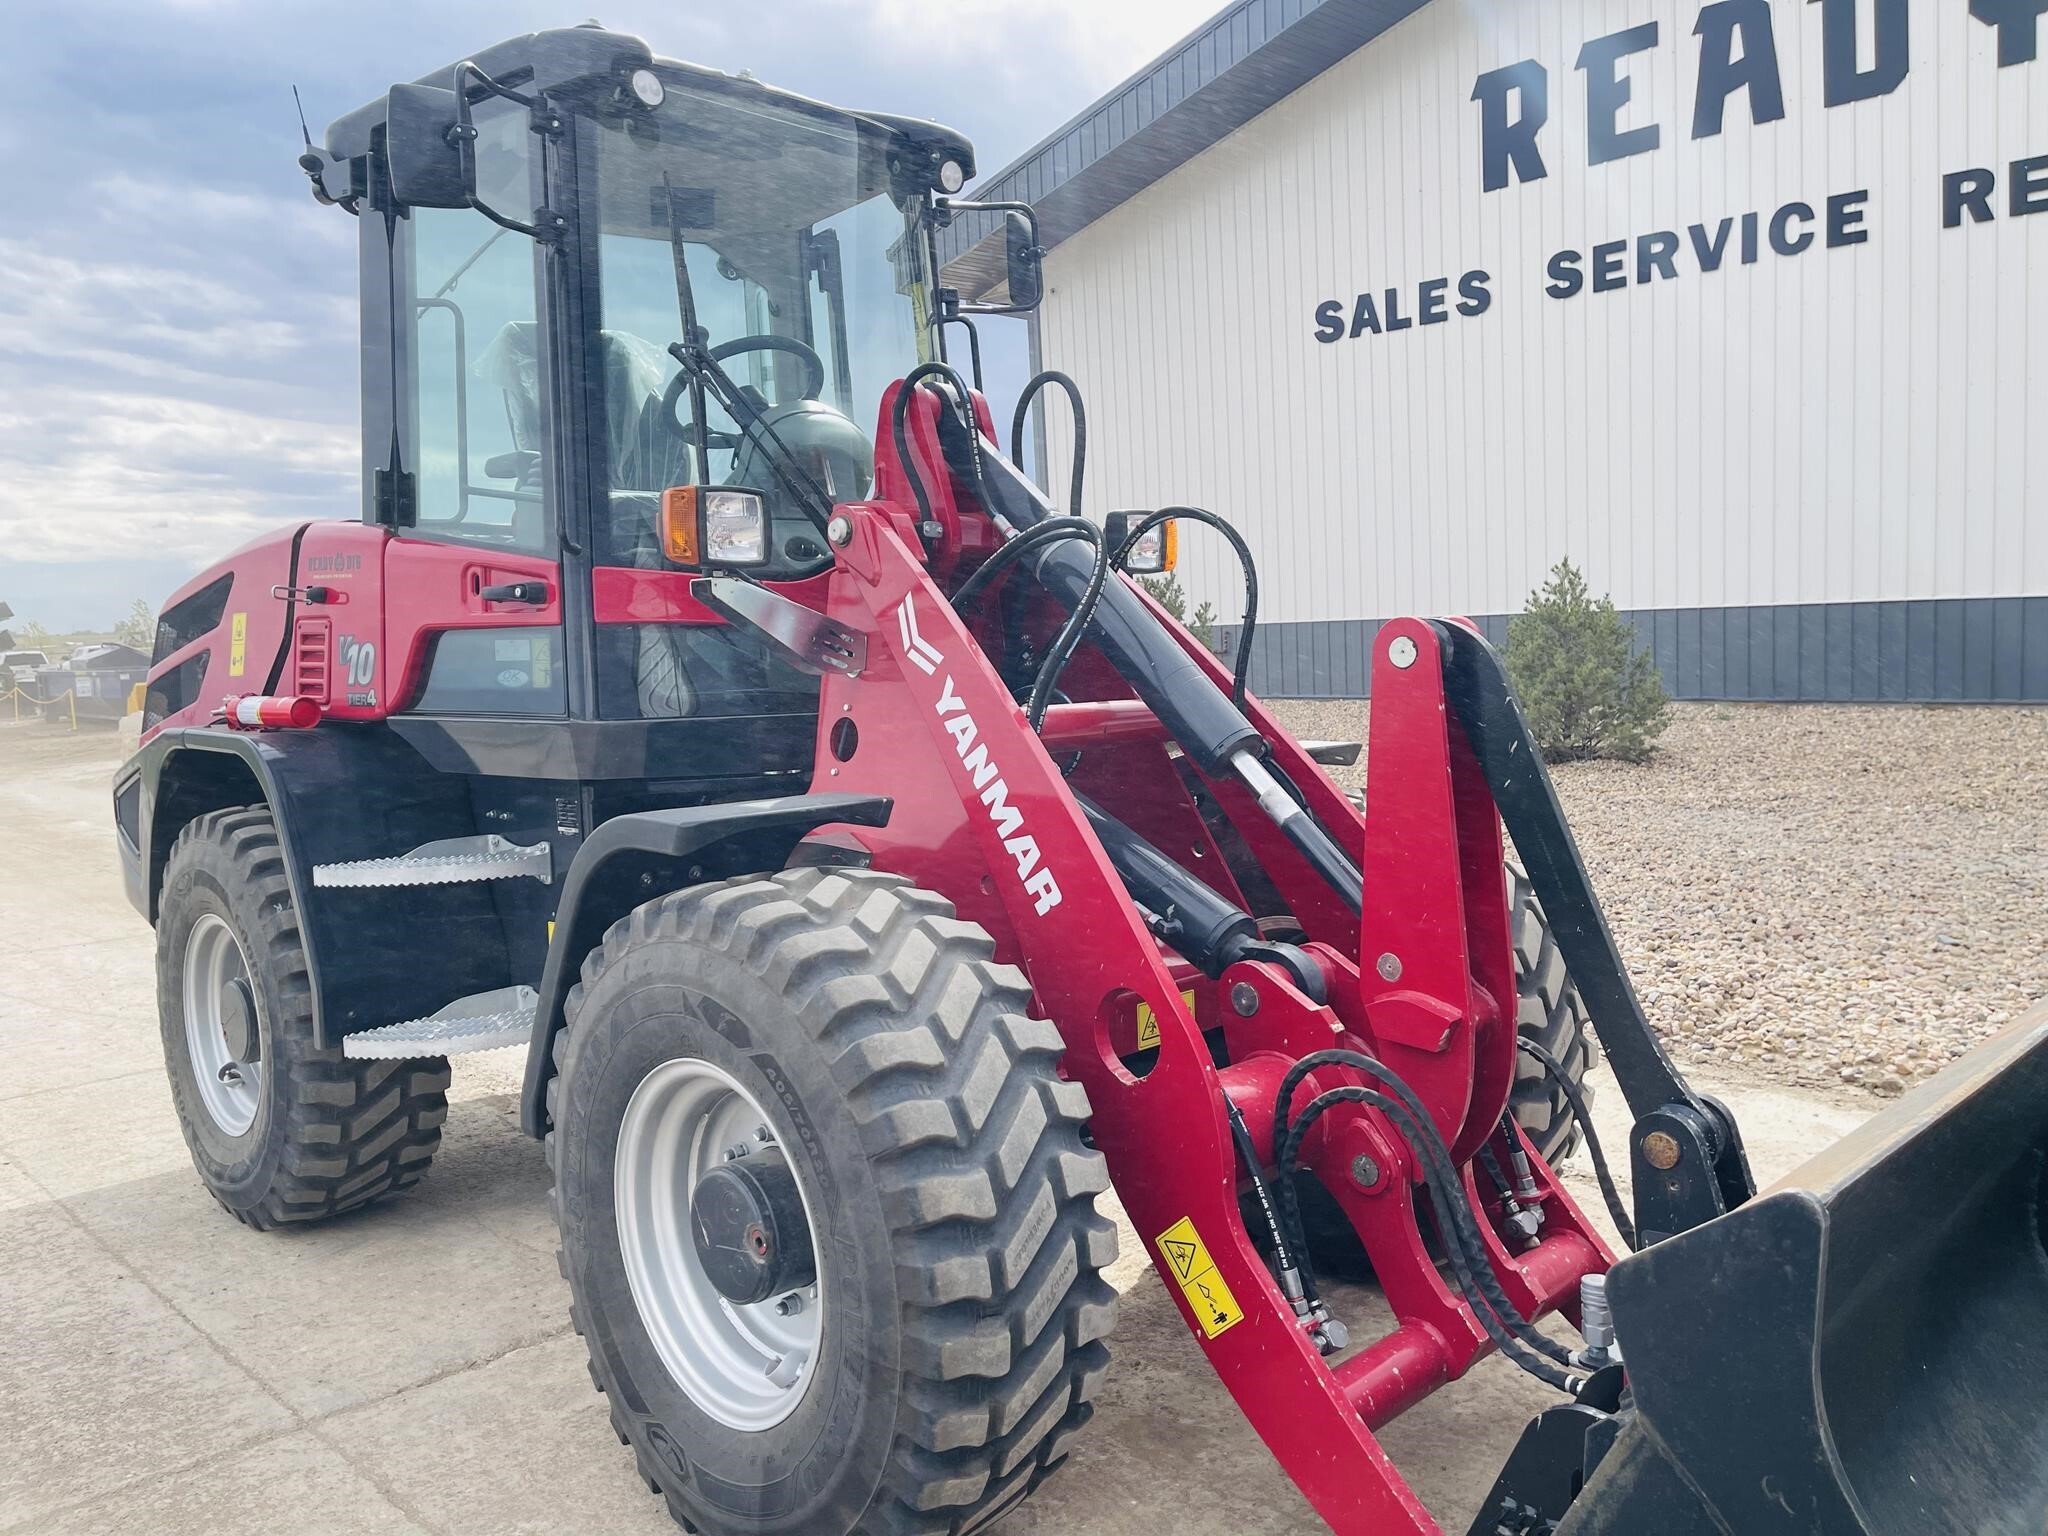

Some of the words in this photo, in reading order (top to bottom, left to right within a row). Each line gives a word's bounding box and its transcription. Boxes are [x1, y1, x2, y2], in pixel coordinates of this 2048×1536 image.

[1314, 269, 1491, 344] SALES
[1545, 190, 1869, 300] SERVICE
[1942, 154, 2048, 229] RE
[935, 674, 1063, 917] YANMAR
